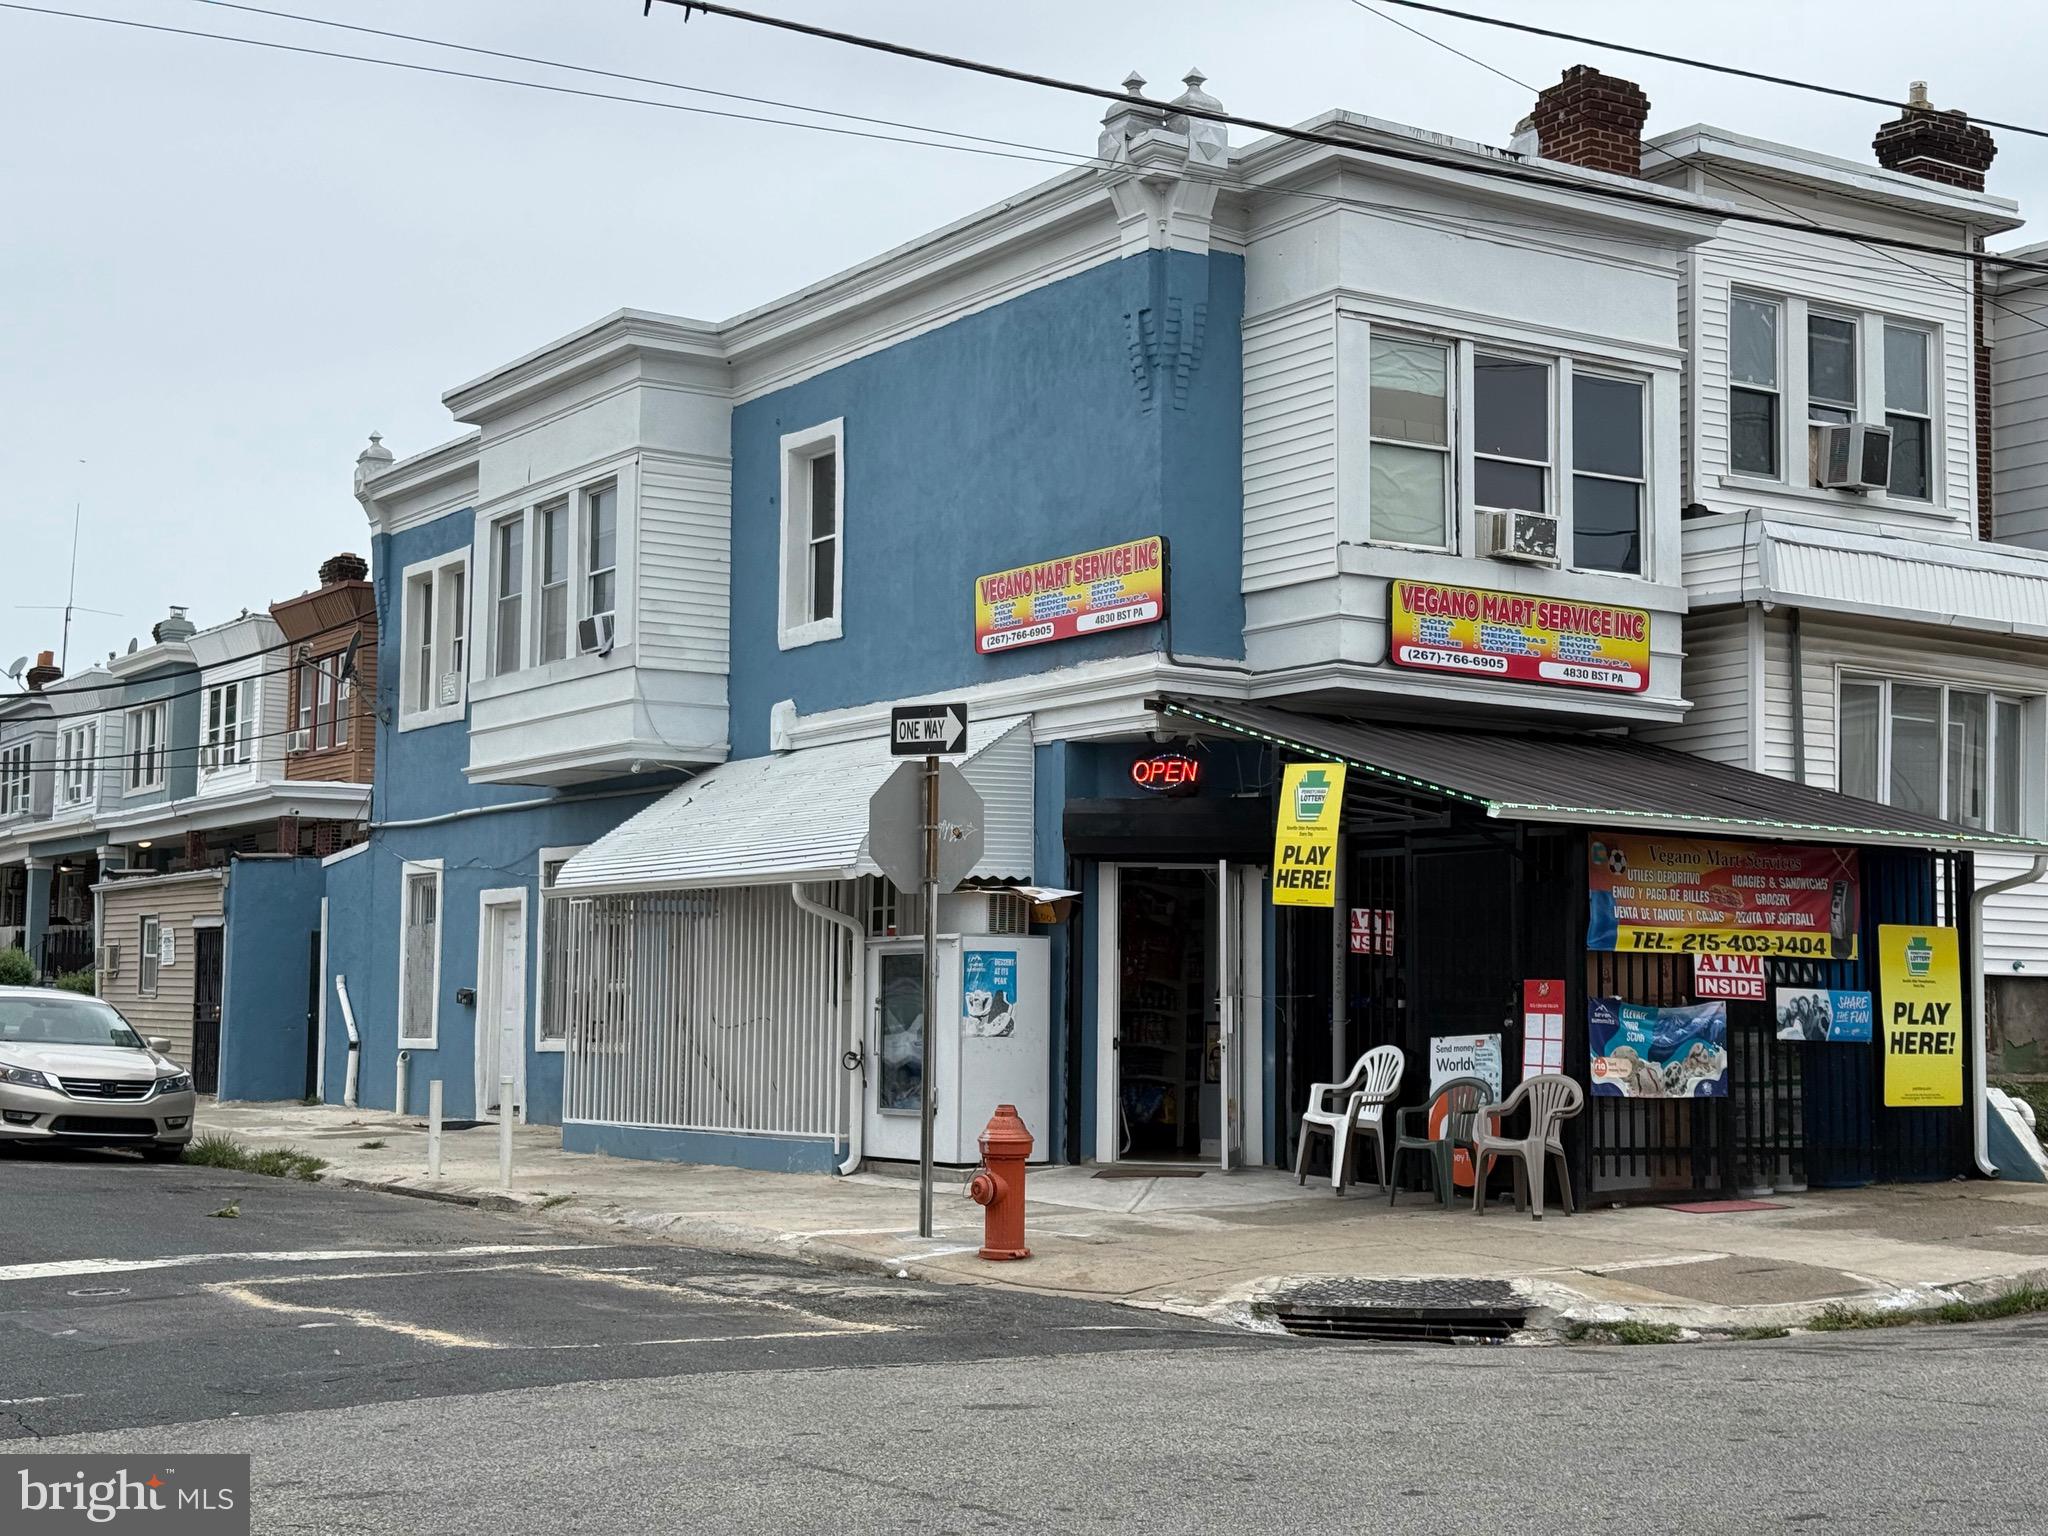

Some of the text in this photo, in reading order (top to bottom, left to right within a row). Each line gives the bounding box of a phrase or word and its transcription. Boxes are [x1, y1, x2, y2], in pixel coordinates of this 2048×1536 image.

[980, 540, 1159, 604] VEGANO MART SERVICE INC
[1091, 579, 1121, 591] SPORT
[1091, 585, 1125, 597] ENVIOS
[1034, 592, 1063, 602] ROPAS
[1034, 594, 1082, 608] MEDICINAS
[1091, 593, 1117, 603] AUTO
[994, 602, 1017, 611] SODA
[994, 608, 1013, 617] MILK
[1399, 583, 1646, 641] VEGANO MART SERVICE INC
[994, 615, 1013, 623] CHIP
[1095, 607, 1144, 625] 4830 BST PA
[1420, 618, 1455, 627] SODA
[1420, 624, 1449, 632] MILK
[1481, 625, 1522, 634] ROPAS
[986, 625, 1052, 648] (267)-766-6905
[1420, 638, 1463, 647] PHONE
[1481, 632, 1547, 644] MEDICINAS
[1560, 634, 1598, 644] SPORT
[1481, 645, 1540, 656] TARJETAS
[1560, 641, 1602, 651] ENVIOS
[1560, 648, 1591, 656] AUTO
[1408, 649, 1504, 668] (267)-766-6905
[1563, 667, 1623, 683] 4830 BST PA
[899, 720, 945, 740] ONE WAY
[1132, 761, 1198, 783] OPEN
[1282, 845, 1331, 865] PLAY
[1648, 844, 1801, 871] Vegano Mart Services
[1276, 869, 1331, 890] HERE!
[1627, 869, 1700, 885] UTILES DEPORTIVO
[1732, 875, 1828, 890] HOAGIES & SANDWICHES
[1612, 885, 1710, 903] ENVIO Y PAGO DE BILLES
[1755, 893, 1791, 906] GROCERY
[1614, 905, 1638, 919] VENTA
[1641, 908, 1651, 920] DE
[1687, 910, 1693, 921] Y
[1696, 910, 1725, 922] CAJAS
[1765, 912, 1776, 924] DE
[1778, 913, 1815, 926] SOFTBALL
[1632, 931, 1826, 955] TEL: 215-403-1404
[1697, 954, 1763, 975] ATM
[1699, 978, 1763, 997] INSIDE
[1837, 996, 1868, 1009] SHARE
[1837, 1010, 1869, 1023] THE FUN
[1893, 1002, 1951, 1025] PLAY
[1436, 1045, 1475, 1053] Send money
[1890, 1031, 1956, 1055] HERE!
